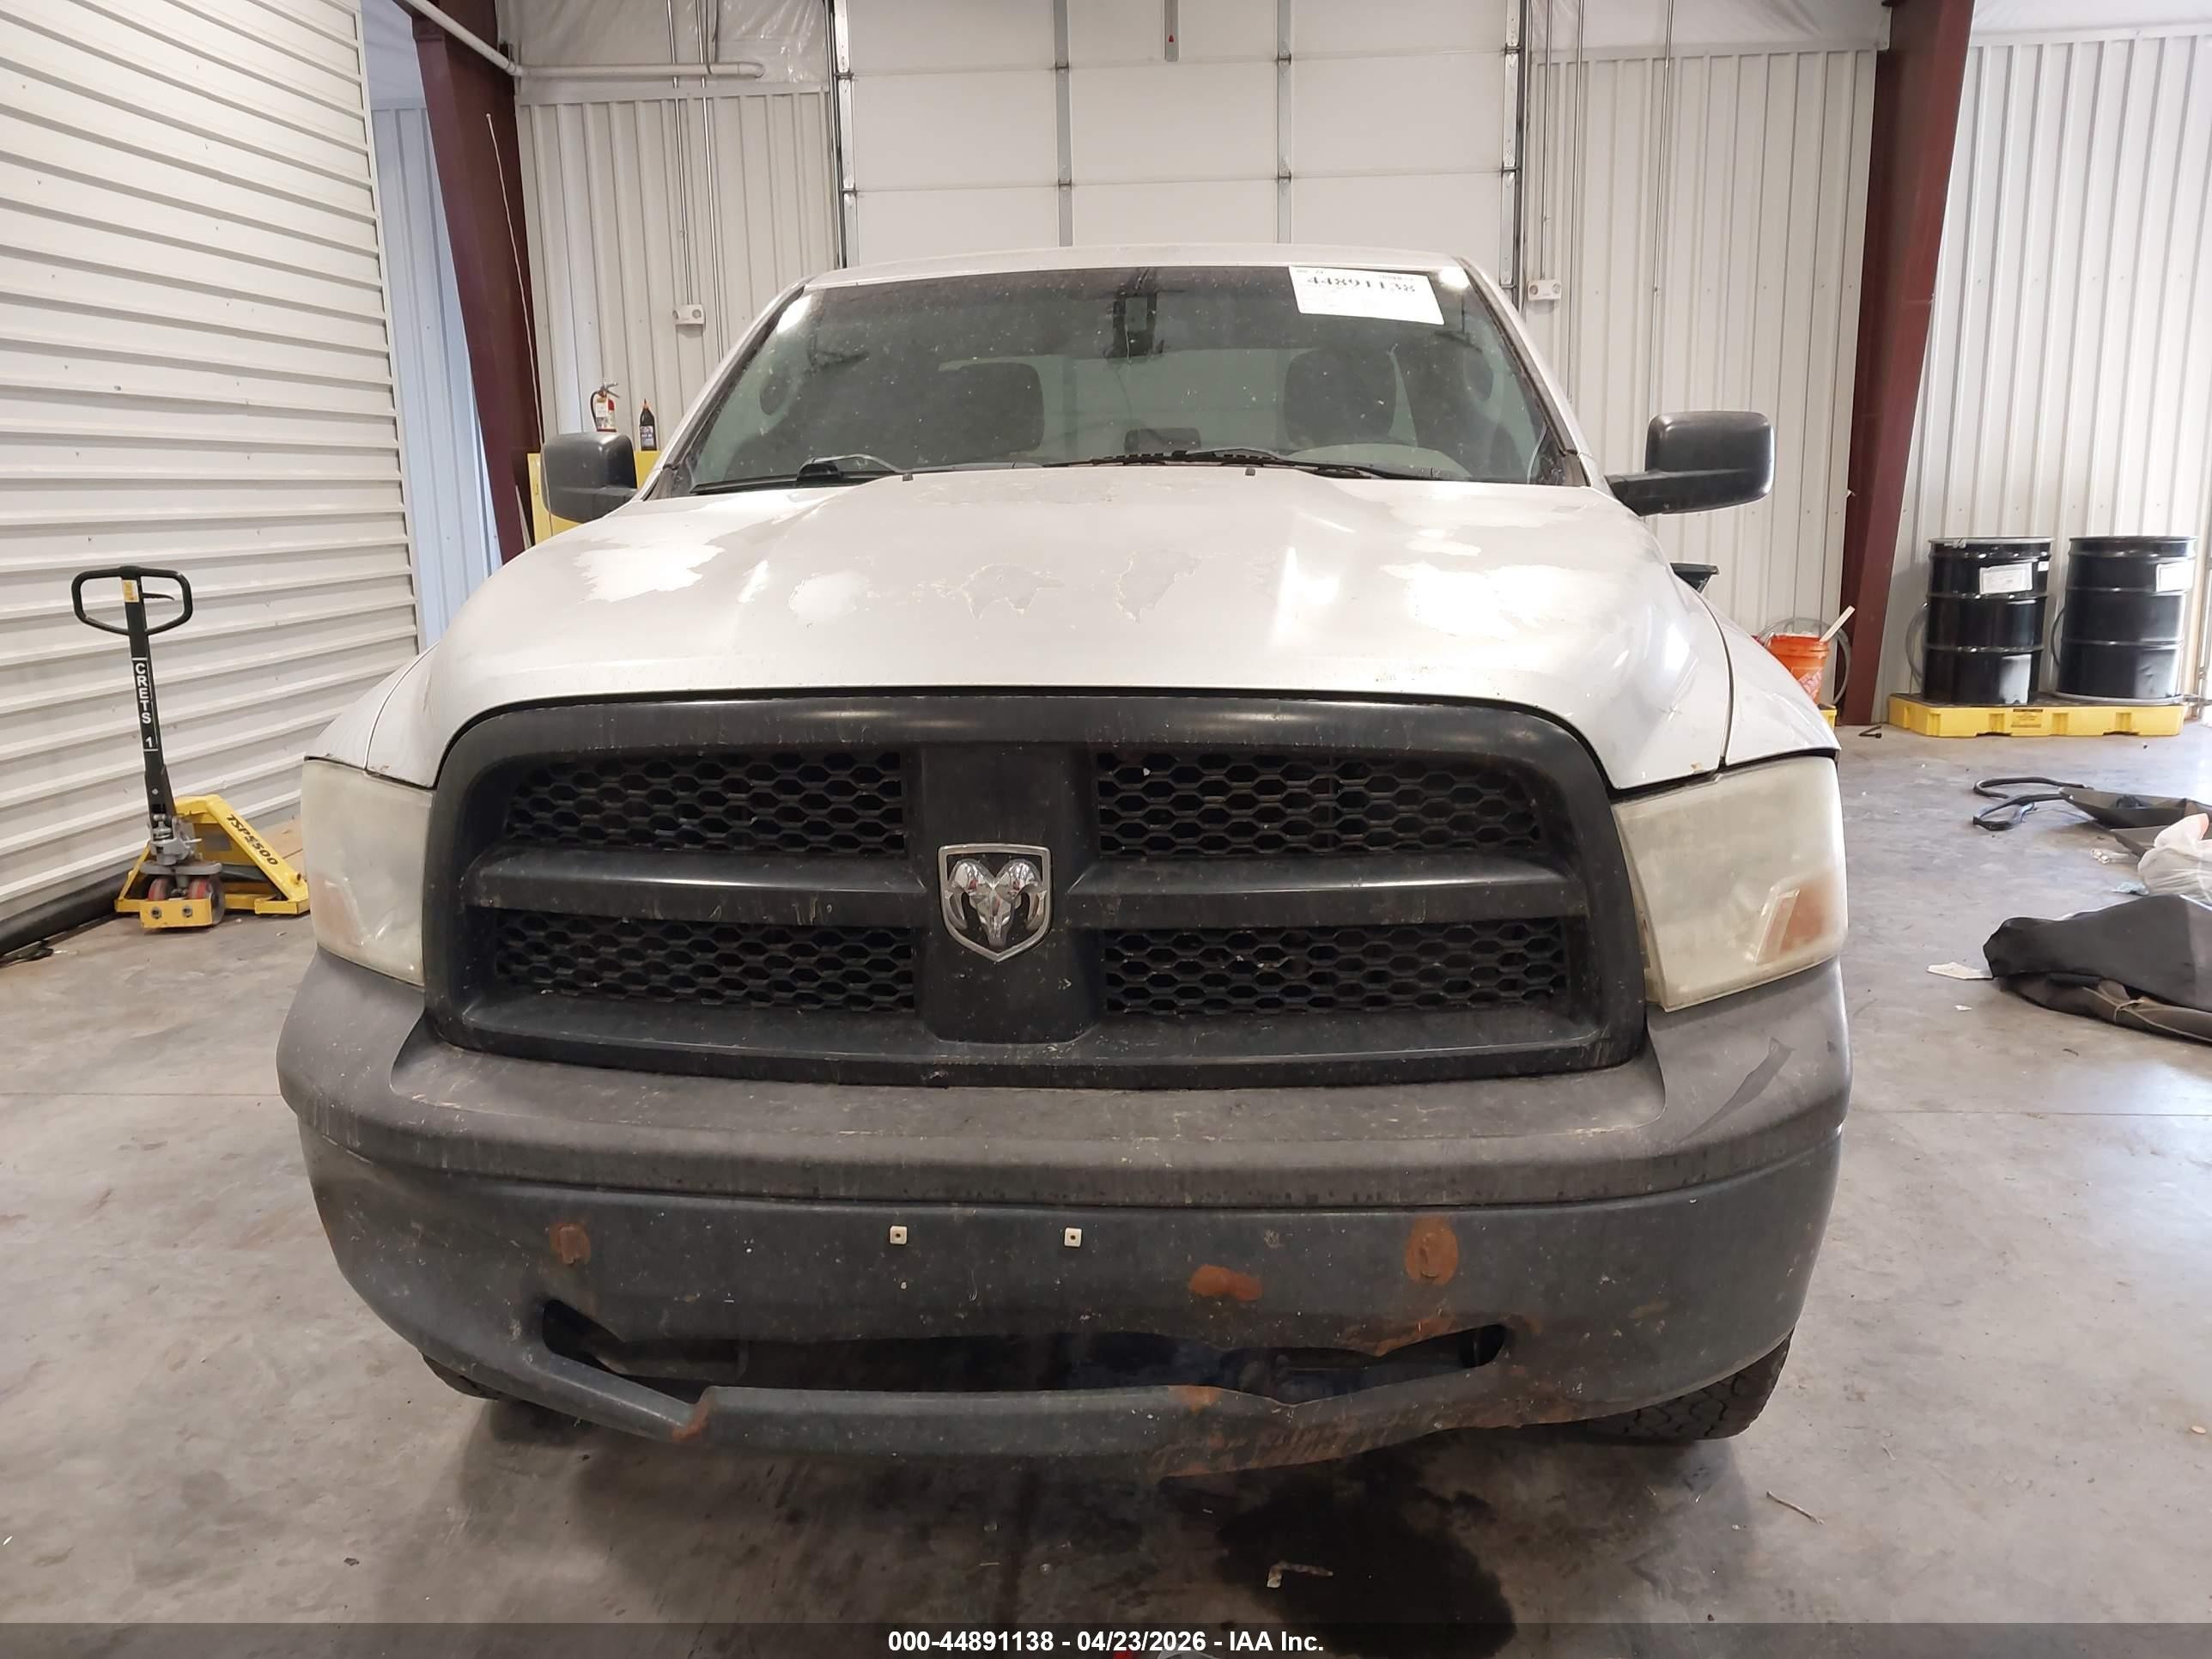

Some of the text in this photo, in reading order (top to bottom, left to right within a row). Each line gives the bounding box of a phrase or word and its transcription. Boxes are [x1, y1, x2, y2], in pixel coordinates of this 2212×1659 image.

[135, 662, 153, 749] CRETS 1
[226, 813, 279, 866] TSP5500
